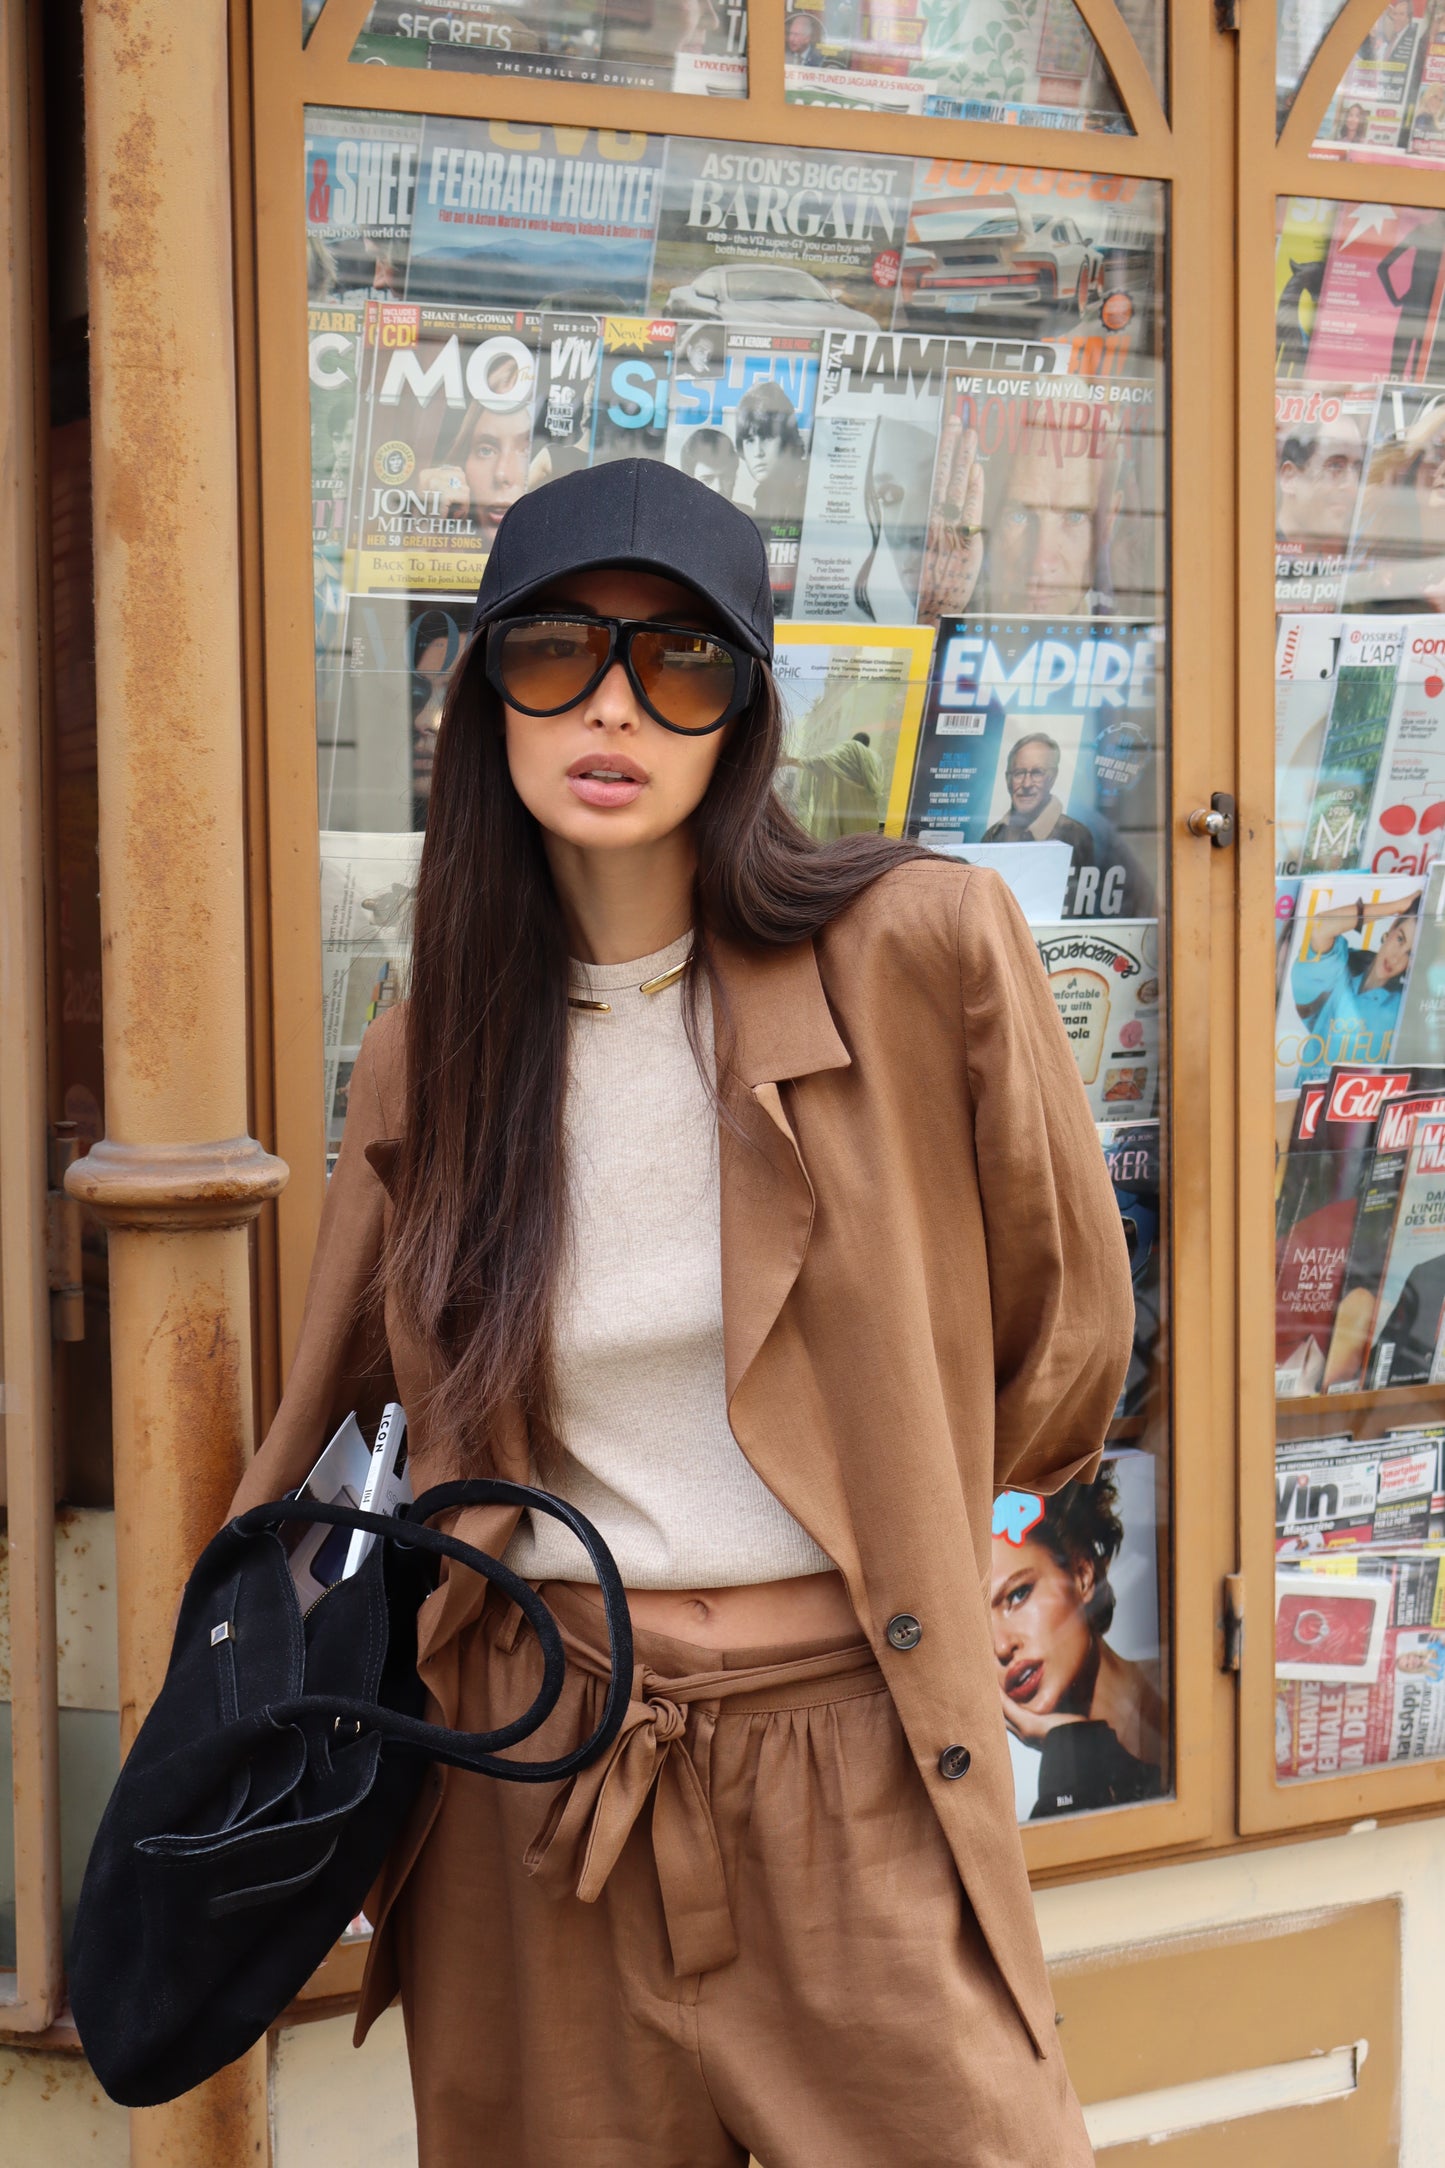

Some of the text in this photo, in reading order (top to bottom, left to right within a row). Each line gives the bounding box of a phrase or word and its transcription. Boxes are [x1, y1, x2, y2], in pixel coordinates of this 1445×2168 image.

[396, 13, 513, 50] SECRETS
[496, 62, 655, 86] THE THRILL OF DRIVING
[694, 60, 719, 71] LYNX
[428, 147, 557, 215] FERRARI
[701, 153, 898, 195] ASTON'S BIGGEST
[685, 179, 900, 243] BARGAIN
[363, 227, 394, 238] world
[733, 233, 748, 245] the
[750, 234, 765, 245] V12
[765, 236, 804, 252] super-GT
[804, 241, 820, 252] you
[821, 242, 836, 251] can
[308, 311, 357, 332] TARR
[421, 311, 456, 321] SHANE
[382, 324, 417, 347] CD!
[608, 322, 642, 340] New!
[379, 333, 536, 416] MO
[823, 340, 847, 398] METAL
[955, 376, 1153, 403] WE LOVE VINYL IS BACK
[368, 488, 443, 520] JONI
[377, 517, 477, 535] MITCHELL
[367, 535, 482, 548] HER 50 GREATEST SONGS
[1292, 560, 1314, 576] su
[955, 624, 1030, 634] WORLD
[939, 637, 1156, 708] EMPIRE
[1067, 978, 1078, 989] A
[1071, 1002, 1092, 1011] with
[375, 1413, 392, 1453] ICON
[1283, 1521, 1335, 1537] Magazine
[1342, 1683, 1369, 1738] DEN
